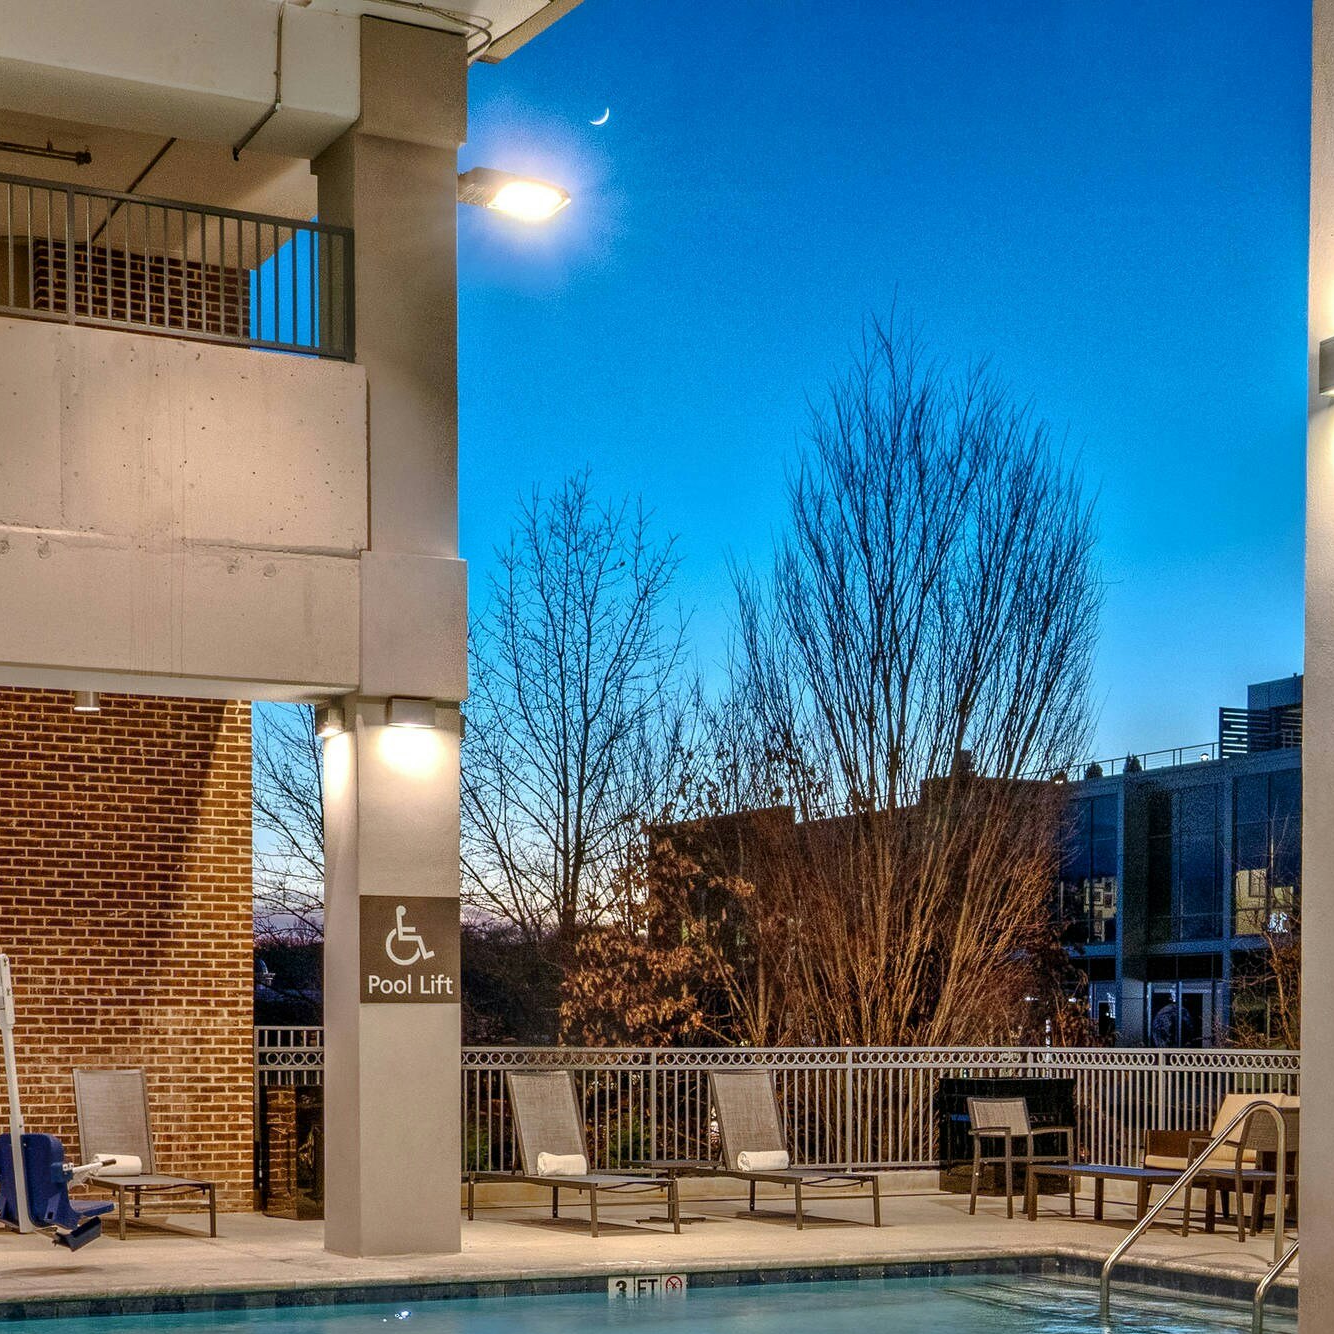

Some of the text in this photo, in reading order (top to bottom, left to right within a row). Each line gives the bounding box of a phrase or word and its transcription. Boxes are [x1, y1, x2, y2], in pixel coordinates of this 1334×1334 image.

[368, 974, 453, 994] Pool Lift
[615, 1279, 658, 1293] 3 FT
